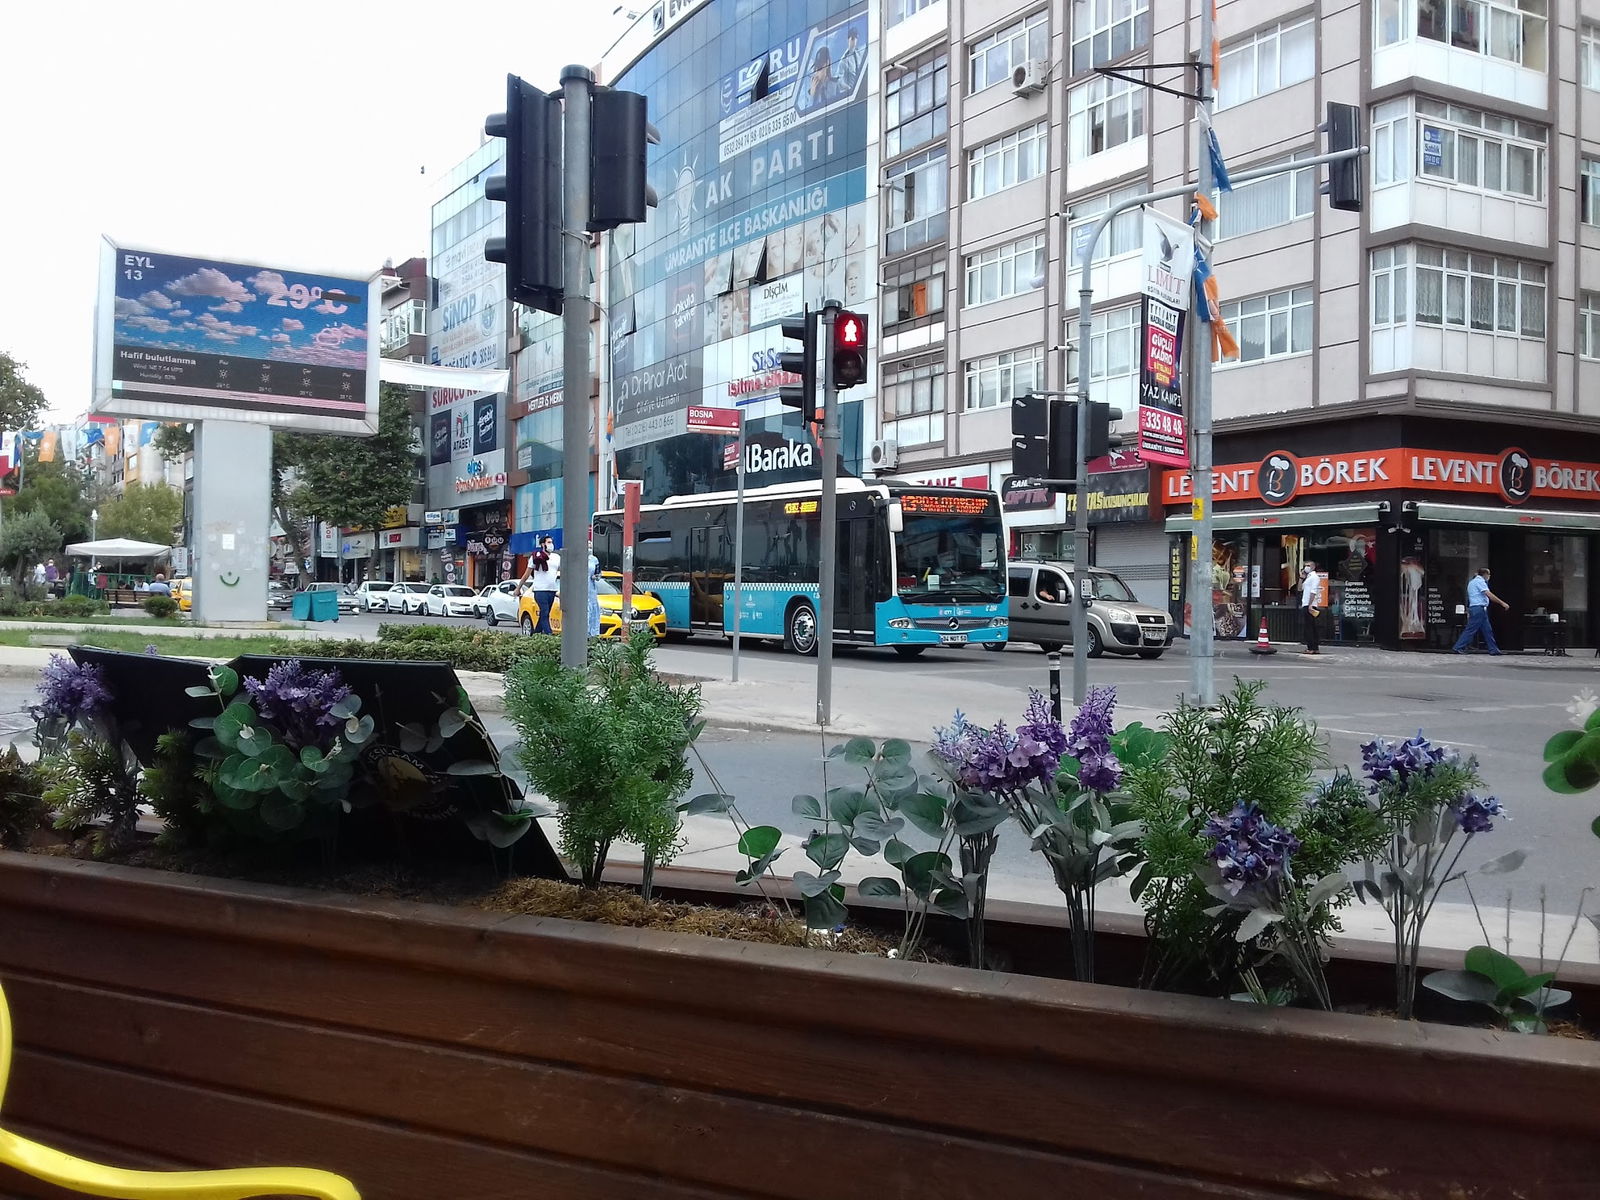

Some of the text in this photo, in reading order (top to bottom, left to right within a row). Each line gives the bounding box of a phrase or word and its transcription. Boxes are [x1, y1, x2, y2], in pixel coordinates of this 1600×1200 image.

[705, 170, 733, 210] AK
[124, 254, 155, 268] EYL
[124, 269, 143, 281] 13
[1151, 333, 1173, 353] GÜÇLÜ
[120, 351, 197, 366] Hafif bulutlanma
[1150, 346, 1173, 366] KADRO
[1141, 382, 1160, 400] YAZ
[688, 408, 714, 420] BOSNA
[1145, 411, 1161, 430] 335
[1162, 415, 1172, 433] 48
[1173, 418, 1183, 436] 48
[1168, 457, 1390, 498] LEENT BÖREK
[1411, 456, 1600, 492] LEVENT BÖREK
